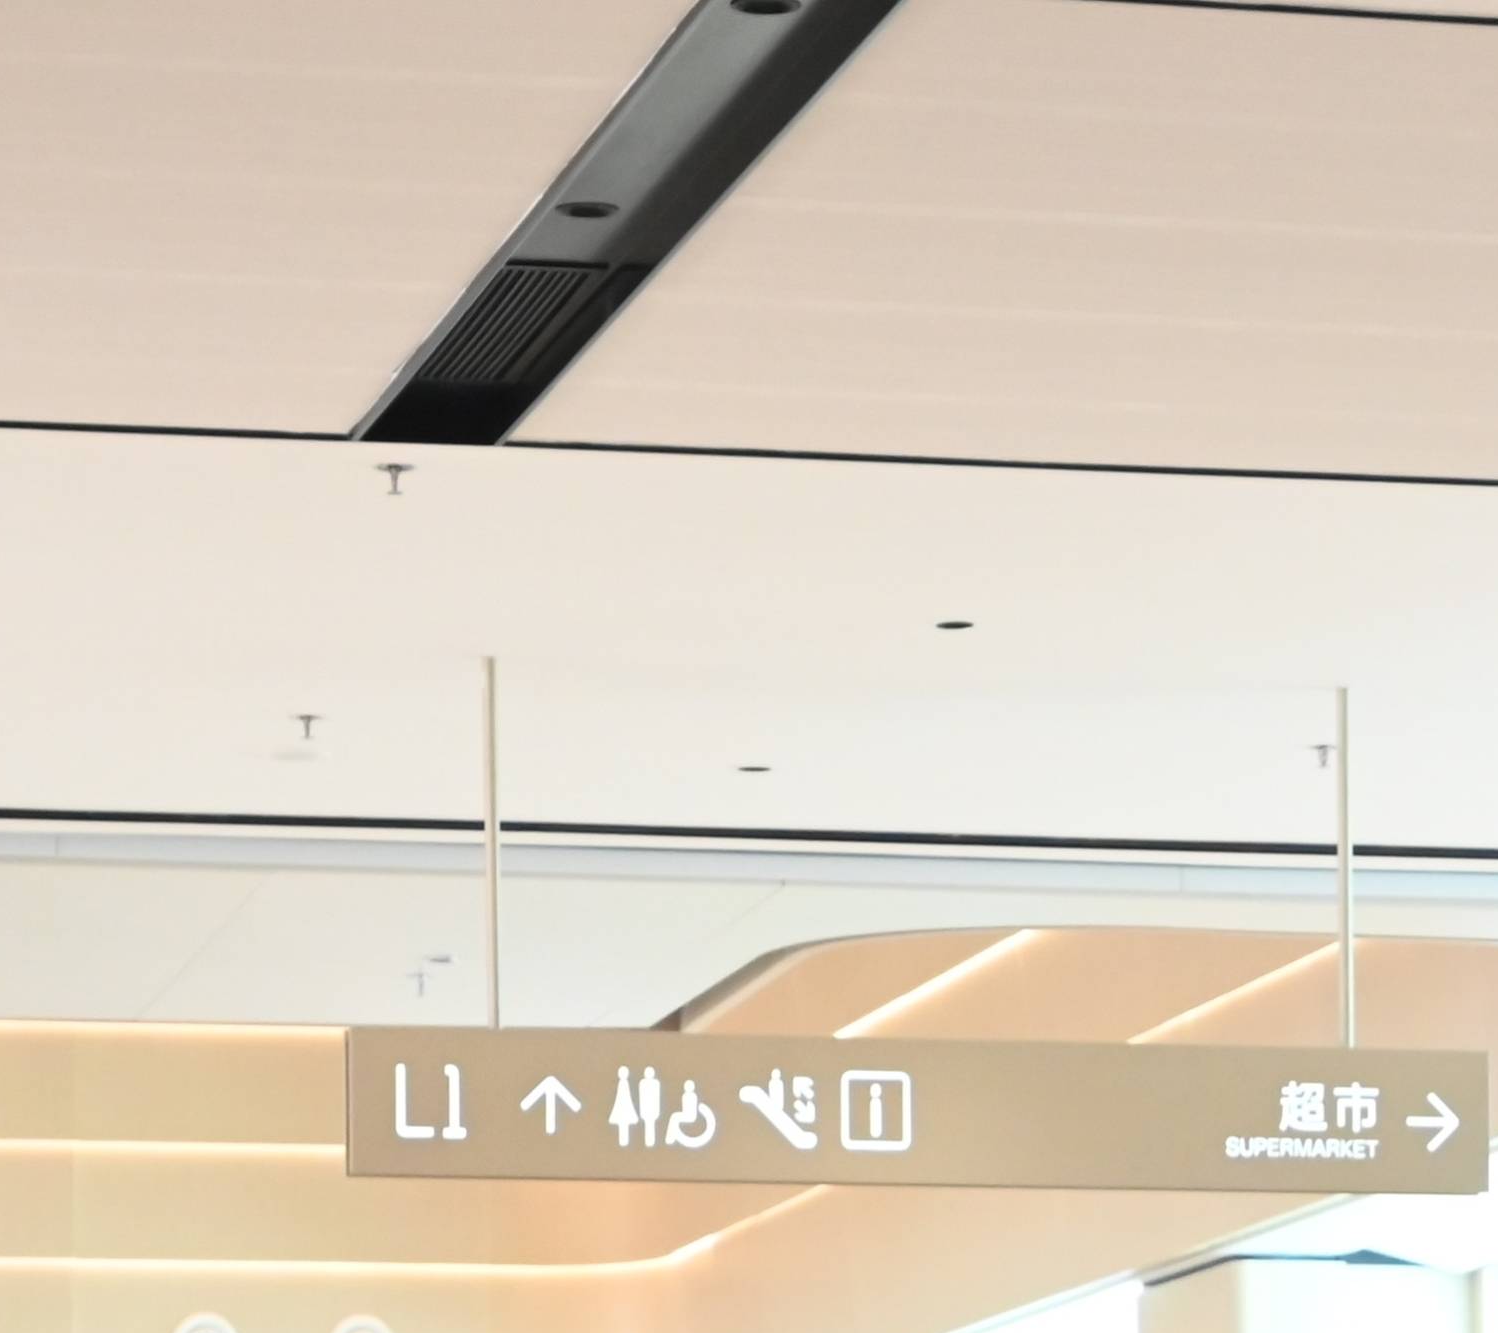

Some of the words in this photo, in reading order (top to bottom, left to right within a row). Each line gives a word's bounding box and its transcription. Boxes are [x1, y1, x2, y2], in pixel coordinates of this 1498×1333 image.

[394, 1062, 467, 1140] L1
[1279, 1080, 1380, 1133] 超市
[1225, 1135, 1380, 1160] SUPERMARKET
